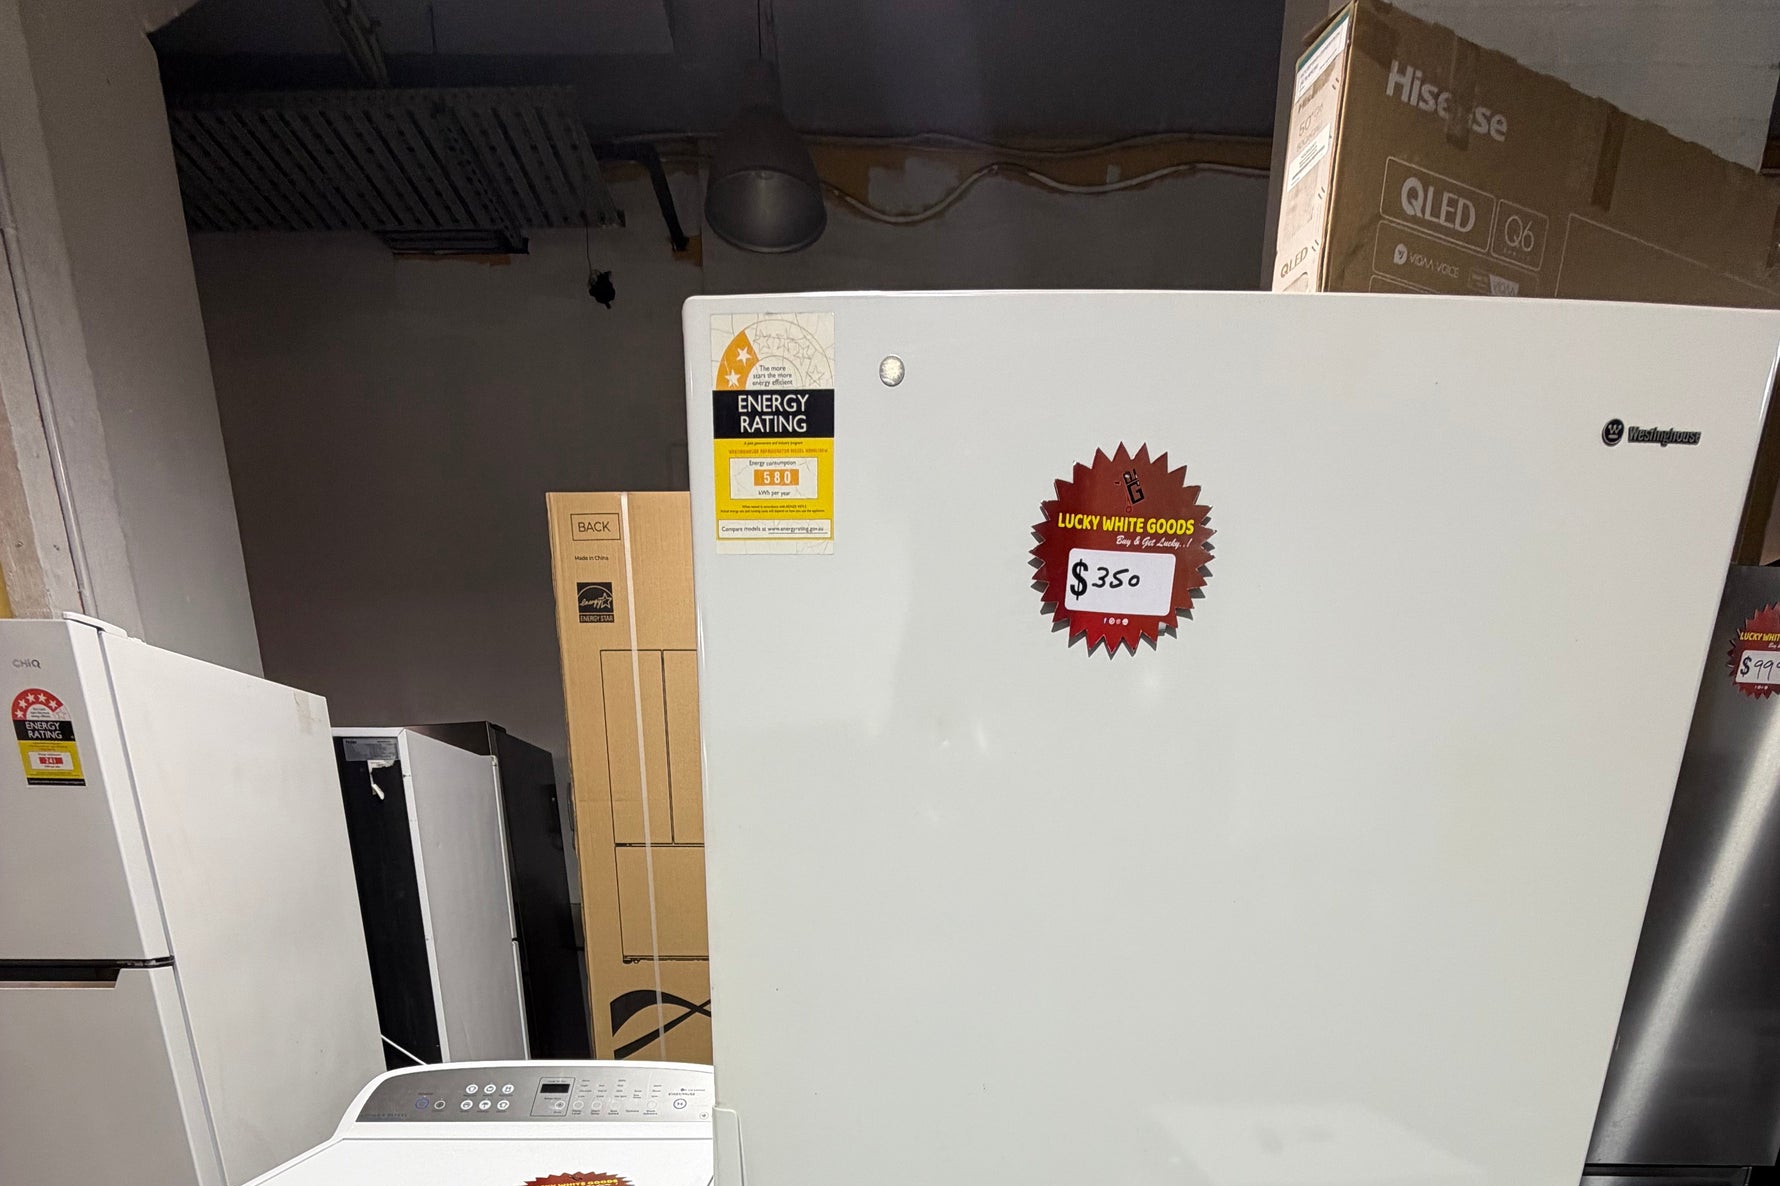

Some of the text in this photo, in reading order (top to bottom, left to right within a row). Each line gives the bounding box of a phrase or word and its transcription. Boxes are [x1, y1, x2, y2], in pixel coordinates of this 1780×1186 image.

[1386, 59, 1507, 142] Hisese
[1401, 177, 1476, 233] QLED
[1504, 215, 1534, 251] Q6
[1280, 247, 1308, 278] QLED
[738, 394, 809, 412] ENERGY
[740, 415, 807, 433] RATING
[1628, 426, 1701, 447] Westinghouse
[763, 471, 791, 484] 580
[578, 521, 611, 532] BACK
[1058, 512, 1195, 535] LUCKY WHITE GOODS
[1116, 535, 1131, 547] Buy
[1142, 536, 1155, 549] Get
[1740, 632, 1762, 640] LUCKY
[25, 721, 60, 730] ENERGY
[28, 731, 62, 739] RATING
